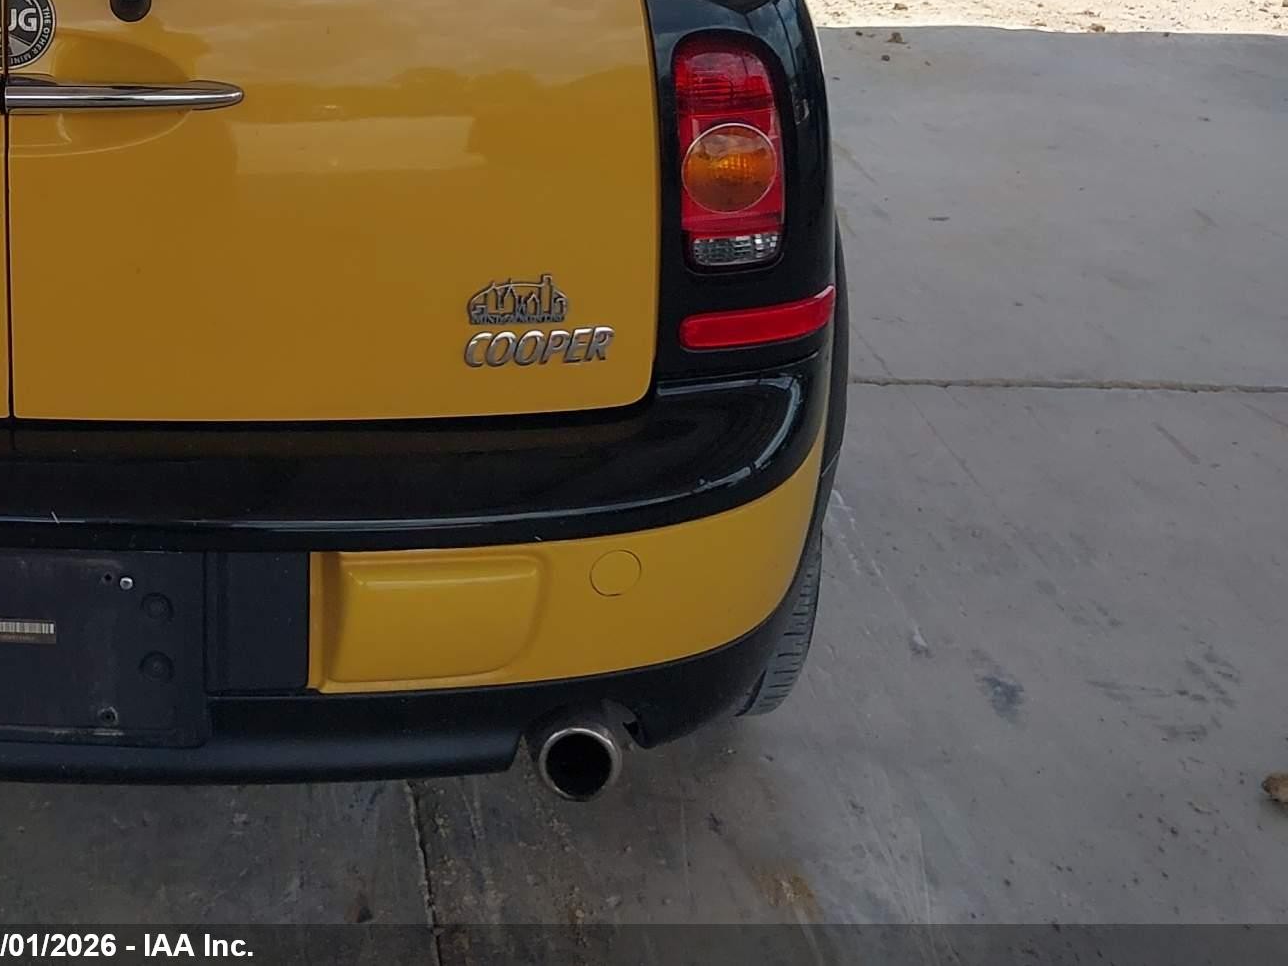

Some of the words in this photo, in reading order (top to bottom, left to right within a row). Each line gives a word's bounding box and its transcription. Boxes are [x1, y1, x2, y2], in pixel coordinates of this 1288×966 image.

[43, 6, 51, 24] THE
[32, 28, 50, 54] OTHER
[10, 54, 31, 65] MINI
[464, 326, 615, 368] COOPER
